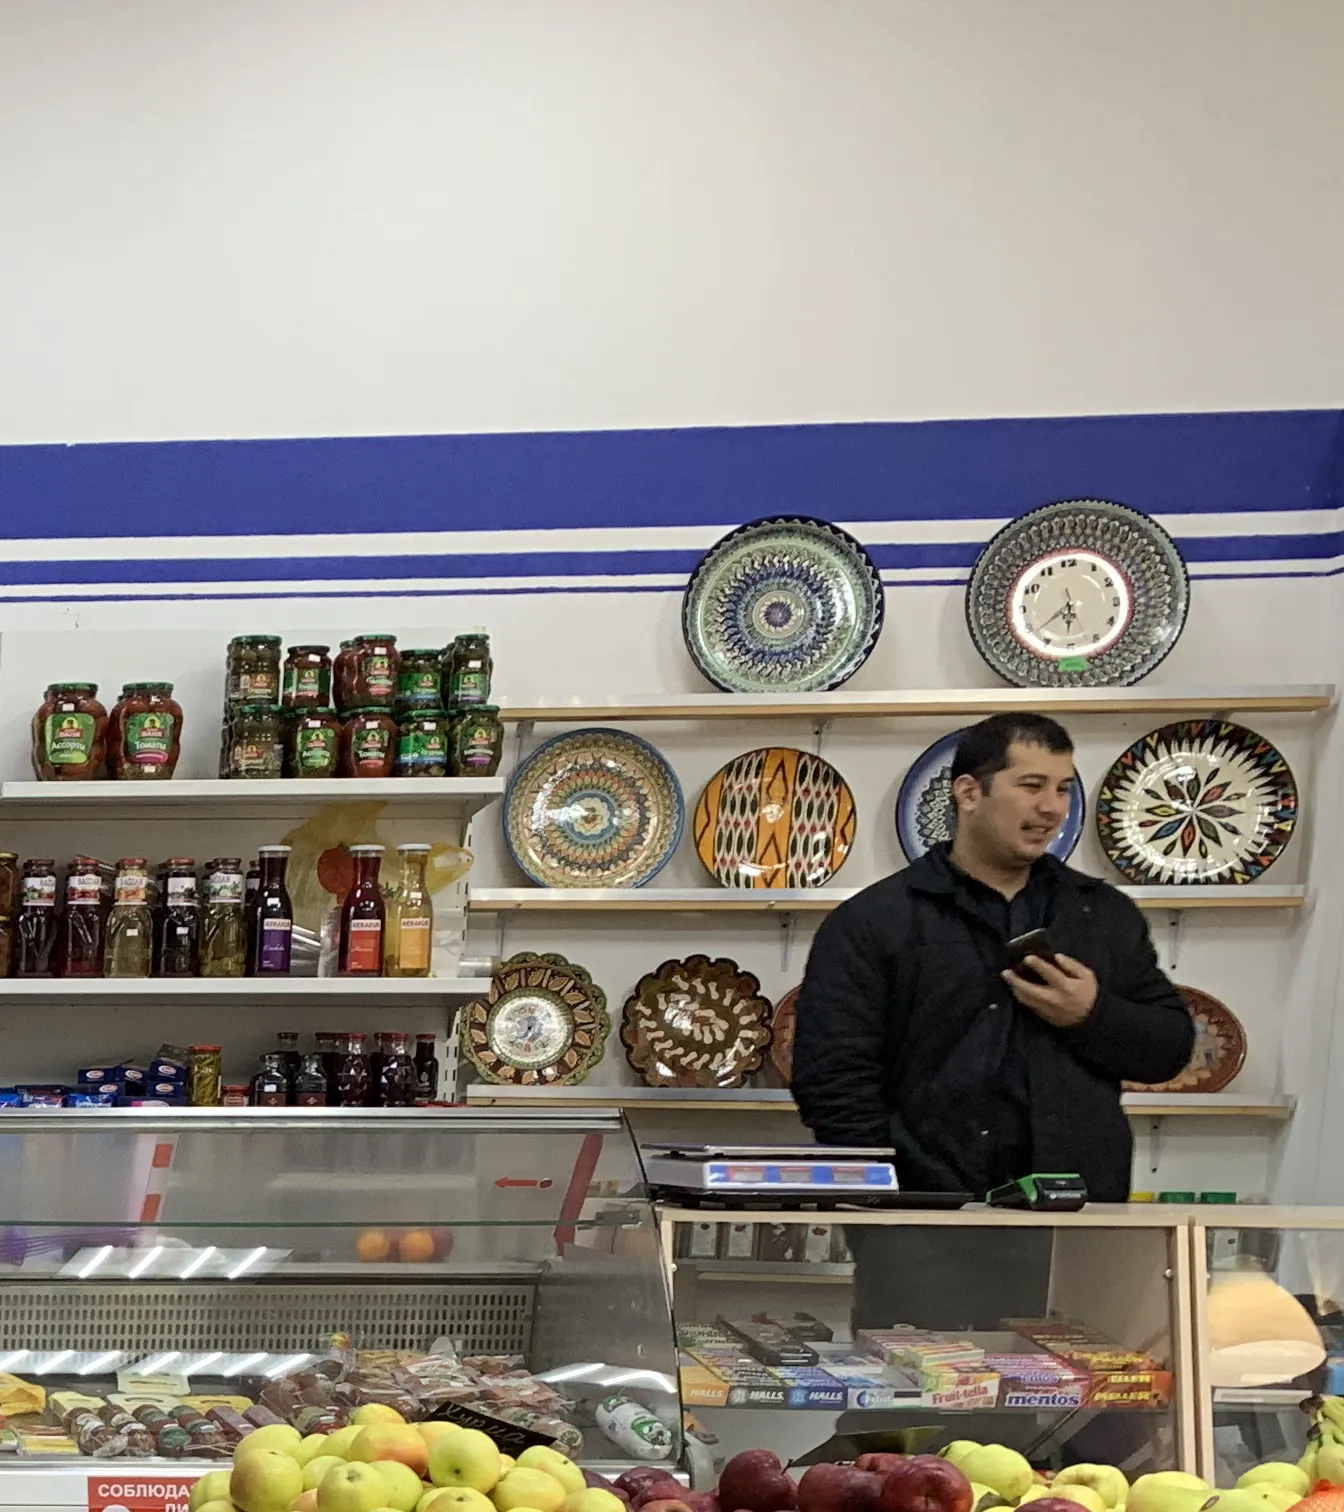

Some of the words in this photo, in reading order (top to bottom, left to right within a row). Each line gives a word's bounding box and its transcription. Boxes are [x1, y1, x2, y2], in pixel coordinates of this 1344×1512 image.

[691, 1389, 723, 1398] HALLS
[750, 1390, 785, 1401] HALLS
[809, 1391, 844, 1401] HALLS
[932, 1384, 989, 1405] Fruit-tella
[1008, 1392, 1081, 1407] mentos
[97, 1484, 193, 1500] СОБЛЮДА
